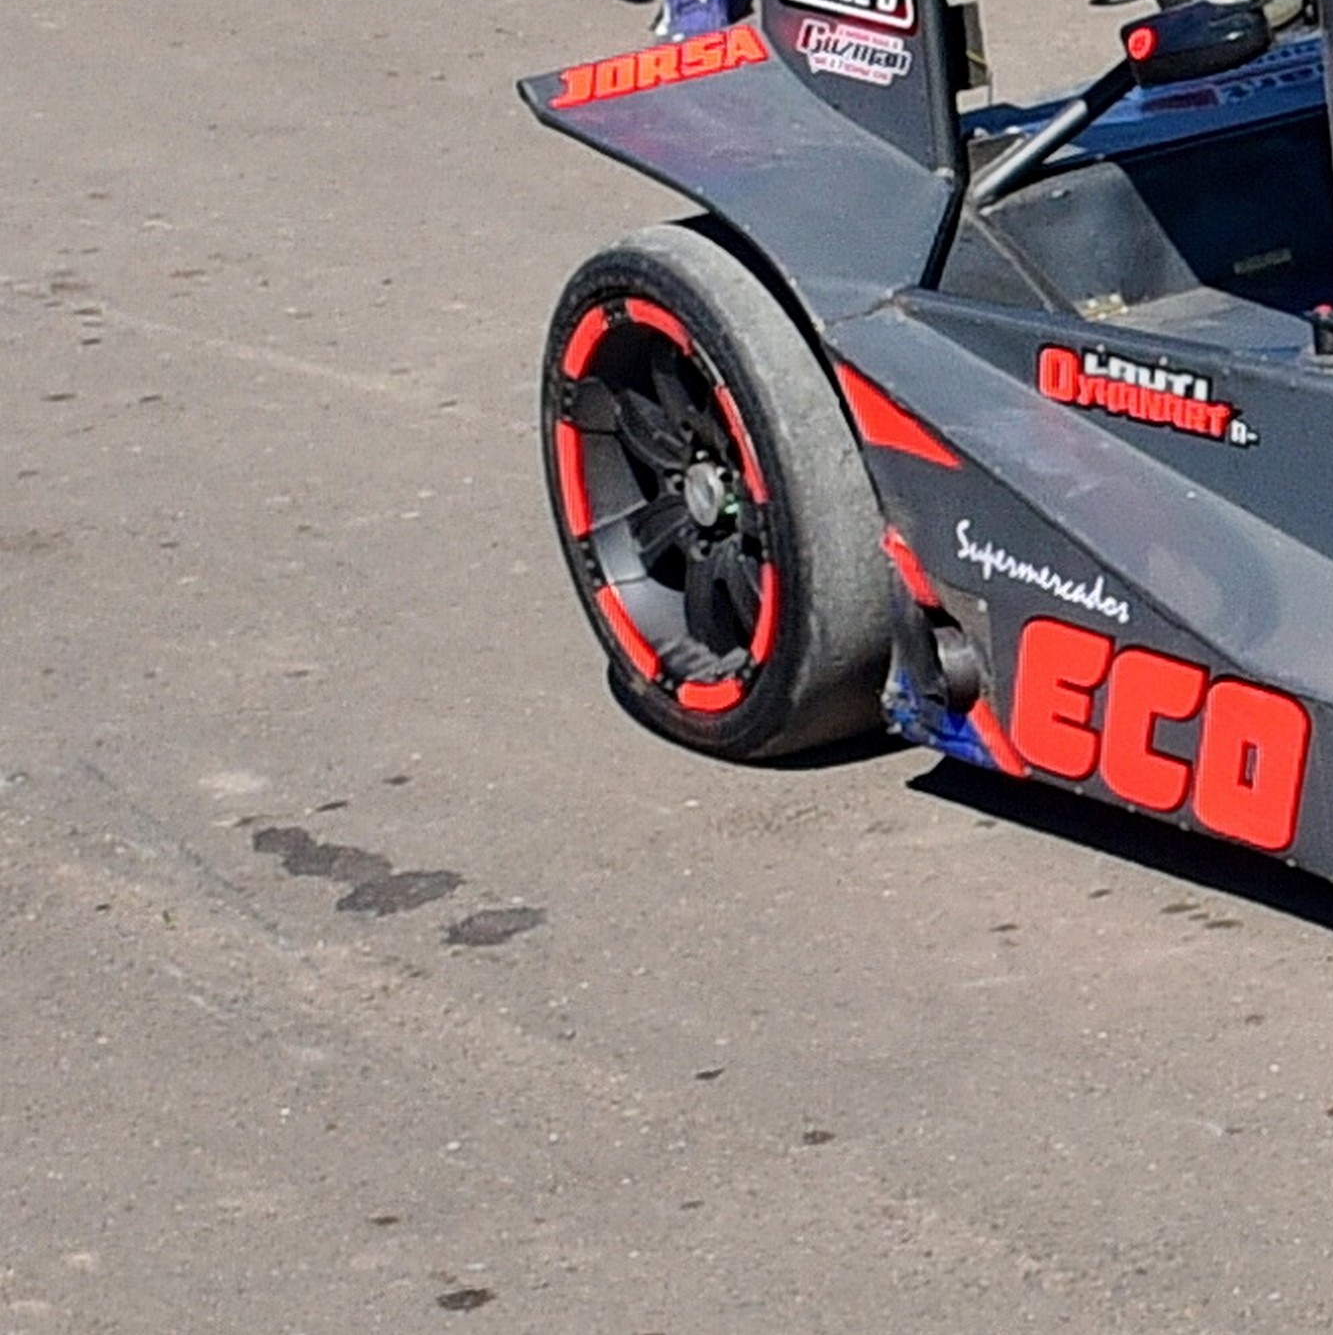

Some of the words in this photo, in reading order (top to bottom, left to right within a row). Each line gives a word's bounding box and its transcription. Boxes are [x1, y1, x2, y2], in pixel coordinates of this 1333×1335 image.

[548, 24, 770, 109] JORSA
[956, 518, 1130, 624] Supermercados
[1010, 616, 1312, 852] ECO
